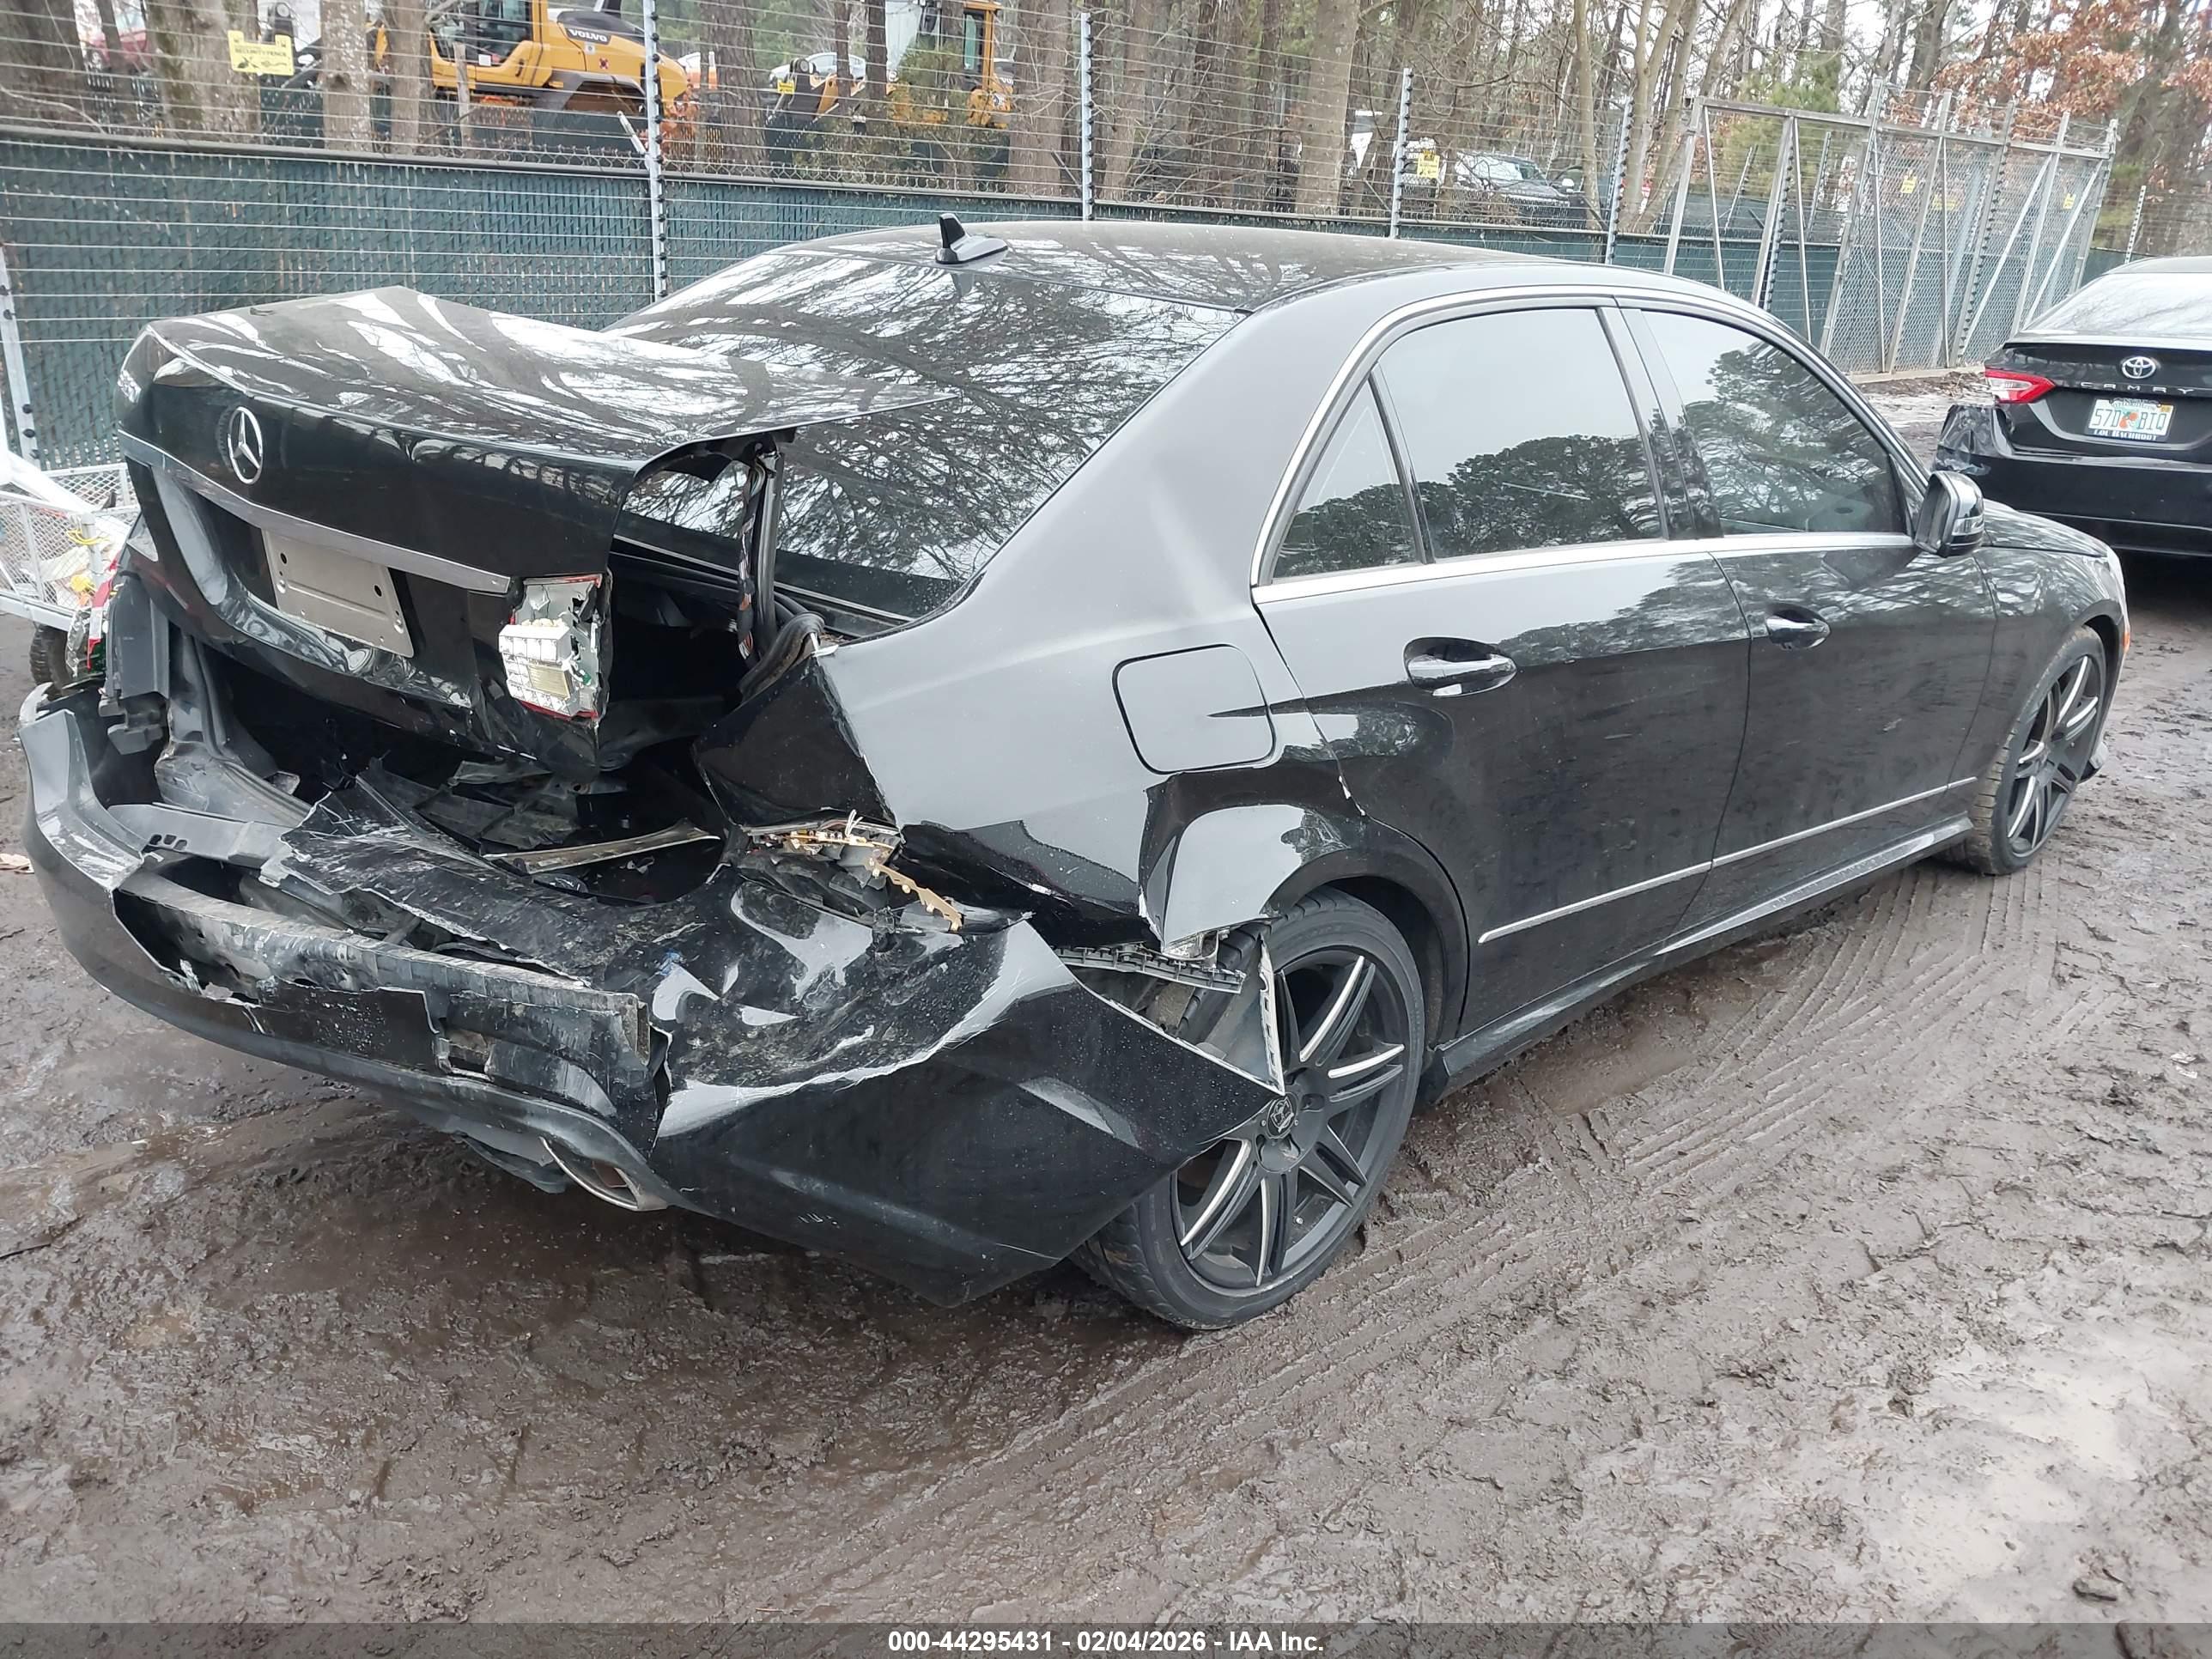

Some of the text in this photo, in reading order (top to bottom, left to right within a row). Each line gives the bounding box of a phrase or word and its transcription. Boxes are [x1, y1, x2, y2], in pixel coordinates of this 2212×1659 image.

[568, 28, 608, 42] VOLVO
[2080, 381, 2195, 394] CAMRY
[2092, 408, 2122, 428] 57D
